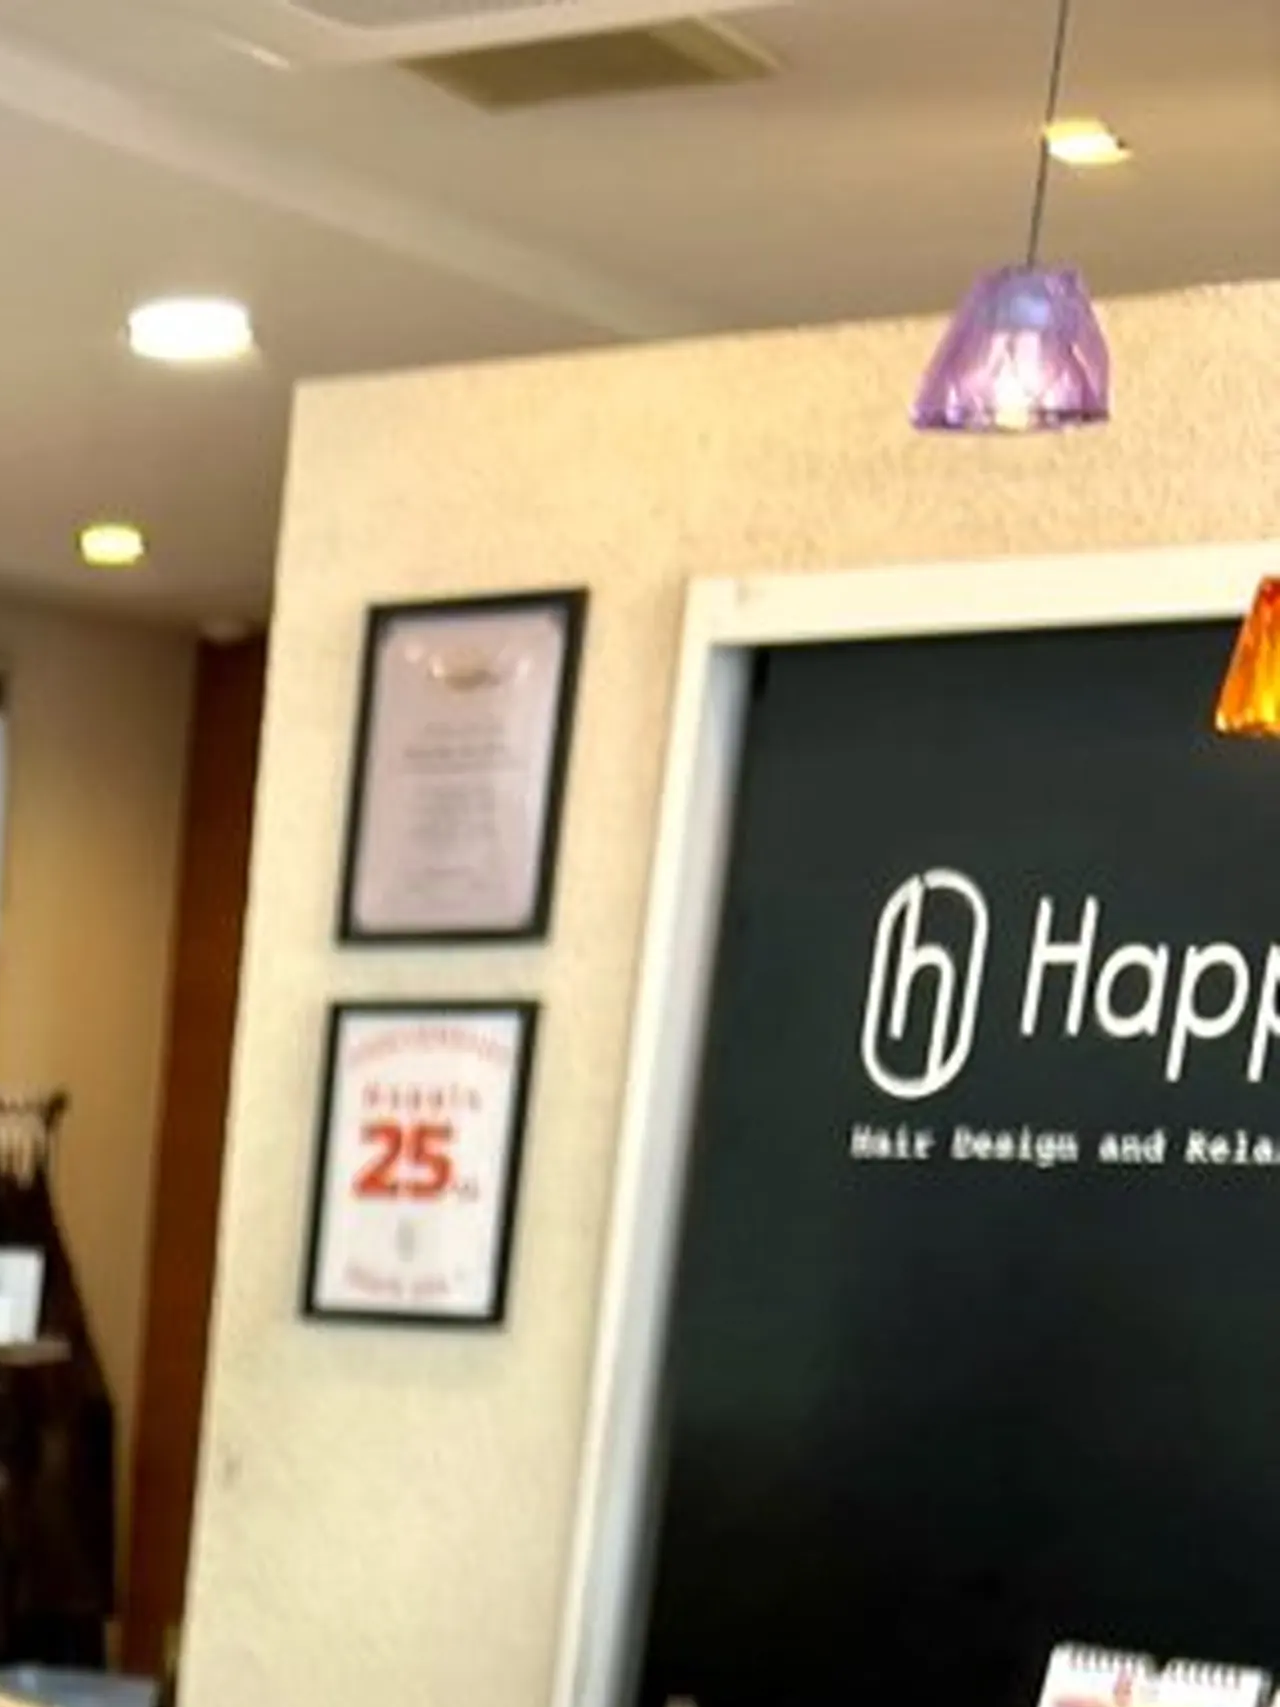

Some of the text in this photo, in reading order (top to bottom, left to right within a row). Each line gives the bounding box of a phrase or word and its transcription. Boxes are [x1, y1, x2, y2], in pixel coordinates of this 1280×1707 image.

[352, 1119, 452, 1202] 25
[850, 1123, 1280, 1168] Hair Design and Rela
